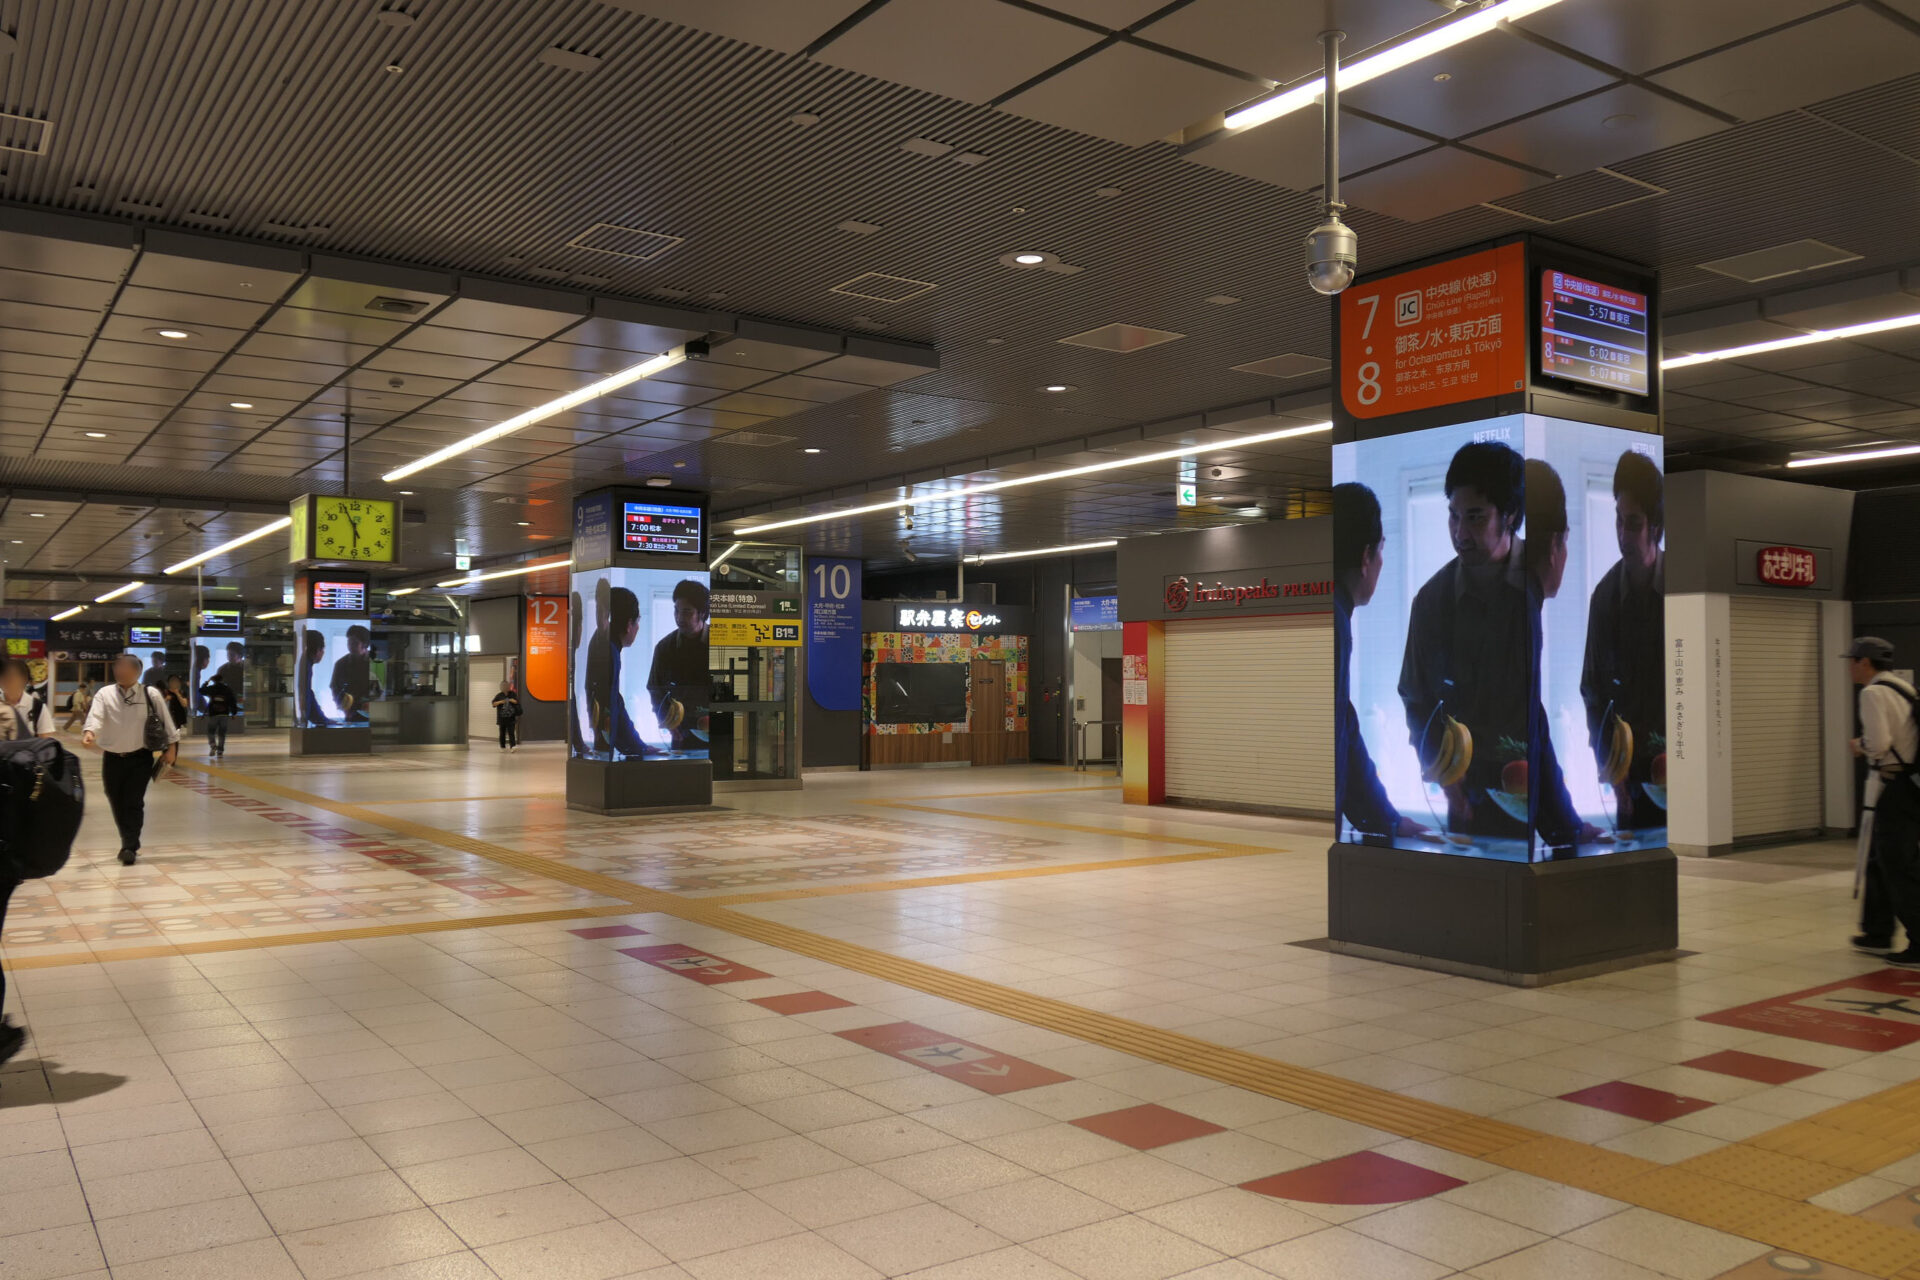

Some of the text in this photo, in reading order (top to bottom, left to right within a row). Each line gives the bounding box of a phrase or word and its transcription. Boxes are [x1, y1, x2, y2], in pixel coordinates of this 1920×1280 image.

[1426, 270, 1497, 300] 中央線(快速)
[1447, 297, 1463, 306] Line
[1463, 288, 1491, 302] (Rapid)
[1357, 294, 1380, 340] 7
[1401, 300, 1416, 317] JC
[1544, 301, 1552, 317] 7
[1589, 304, 1609, 320] 5:57
[1616, 312, 1631, 325] 東京
[1395, 359, 1406, 370] for
[1408, 347, 1463, 367] Ochanomizu
[1464, 344, 1471, 355] &
[1545, 342, 1552, 358] 8
[1589, 345, 1609, 360] 6:02
[1589, 365, 1609, 380] 6:07
[1357, 361, 1382, 406] 8
[1473, 427, 1511, 445] NETFLIX
[1631, 441, 1656, 456] NETFLIX
[350, 503, 361, 511] 12
[327, 513, 338, 521] 10
[375, 515, 383, 523] 2
[577, 506, 584, 527] 9
[321, 524, 329, 532] 9
[631, 524, 649, 532] 7:00
[350, 548, 358, 557] 6
[362, 547, 370, 555] 5
[576, 536, 585, 557] 10
[1763, 550, 1816, 582] あさぎり牛乳
[814, 564, 850, 599] 10
[1194, 581, 1233, 602] fruits
[1235, 577, 1279, 606] peaks
[530, 600, 560, 625] 12
[900, 608, 947, 627] 駅弁屋
[968, 613, 1001, 626] セレクト
